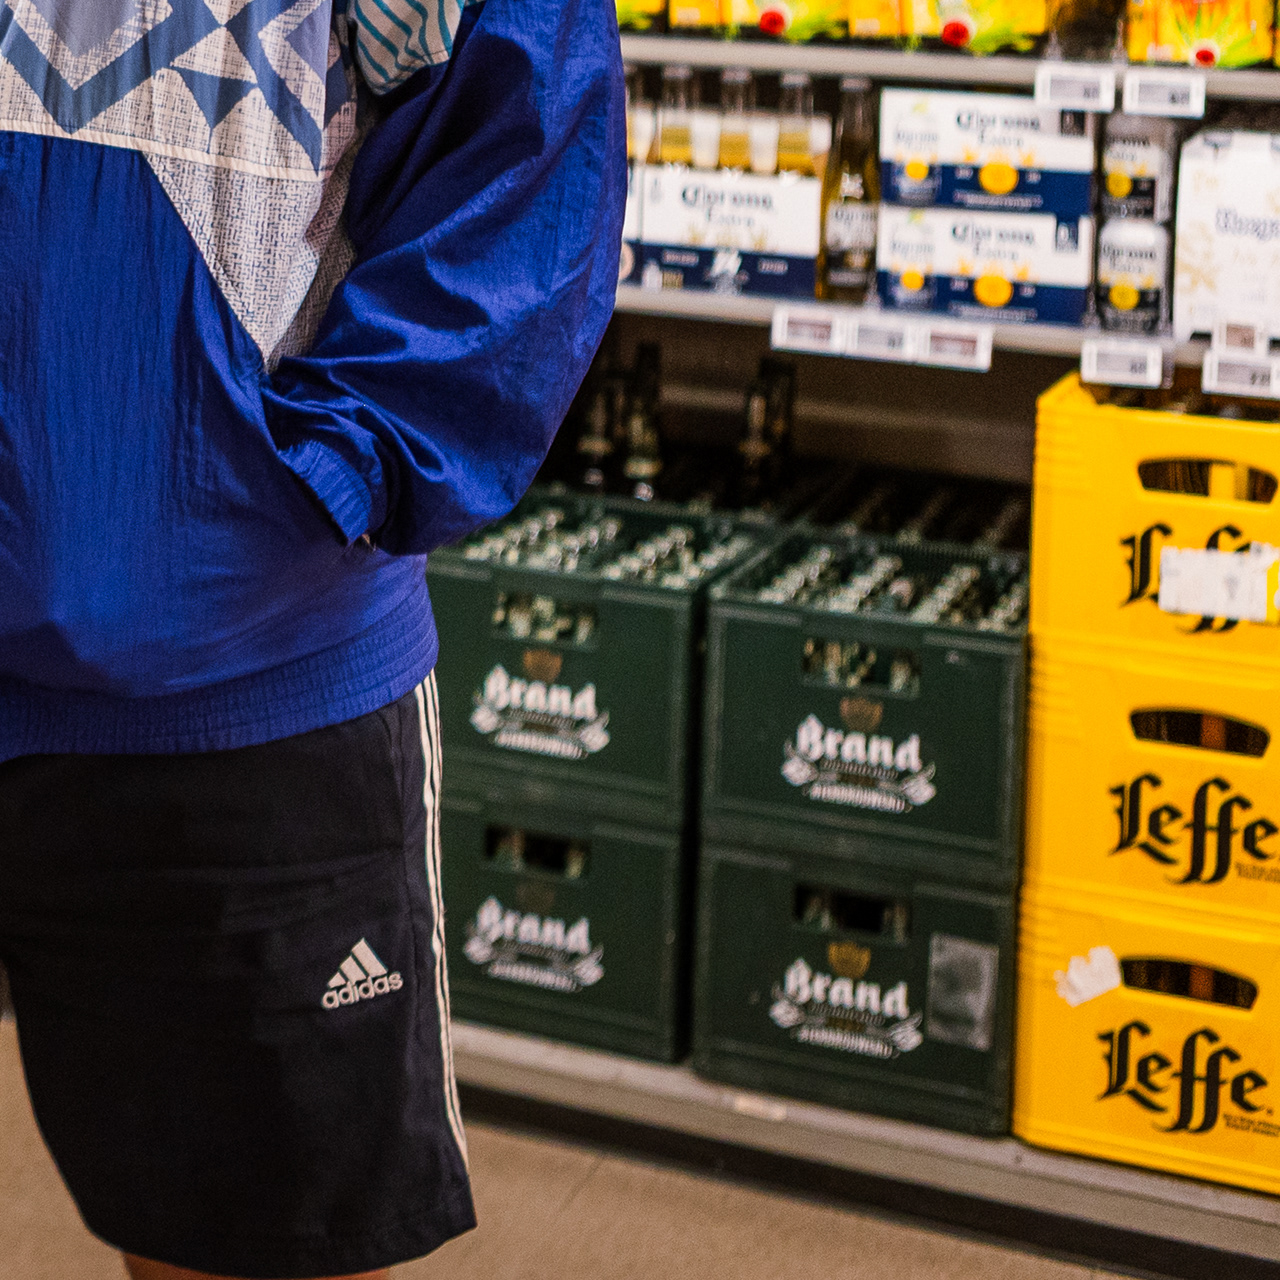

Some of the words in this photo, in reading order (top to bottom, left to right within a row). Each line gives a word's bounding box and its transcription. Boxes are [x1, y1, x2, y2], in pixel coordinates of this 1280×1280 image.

[483, 663, 598, 722] Brand
[796, 712, 923, 773] Brand
[1107, 770, 1280, 888] Leffe
[476, 894, 591, 956] Brand
[321, 971, 404, 1010] adidas
[784, 957, 910, 1020] Brand
